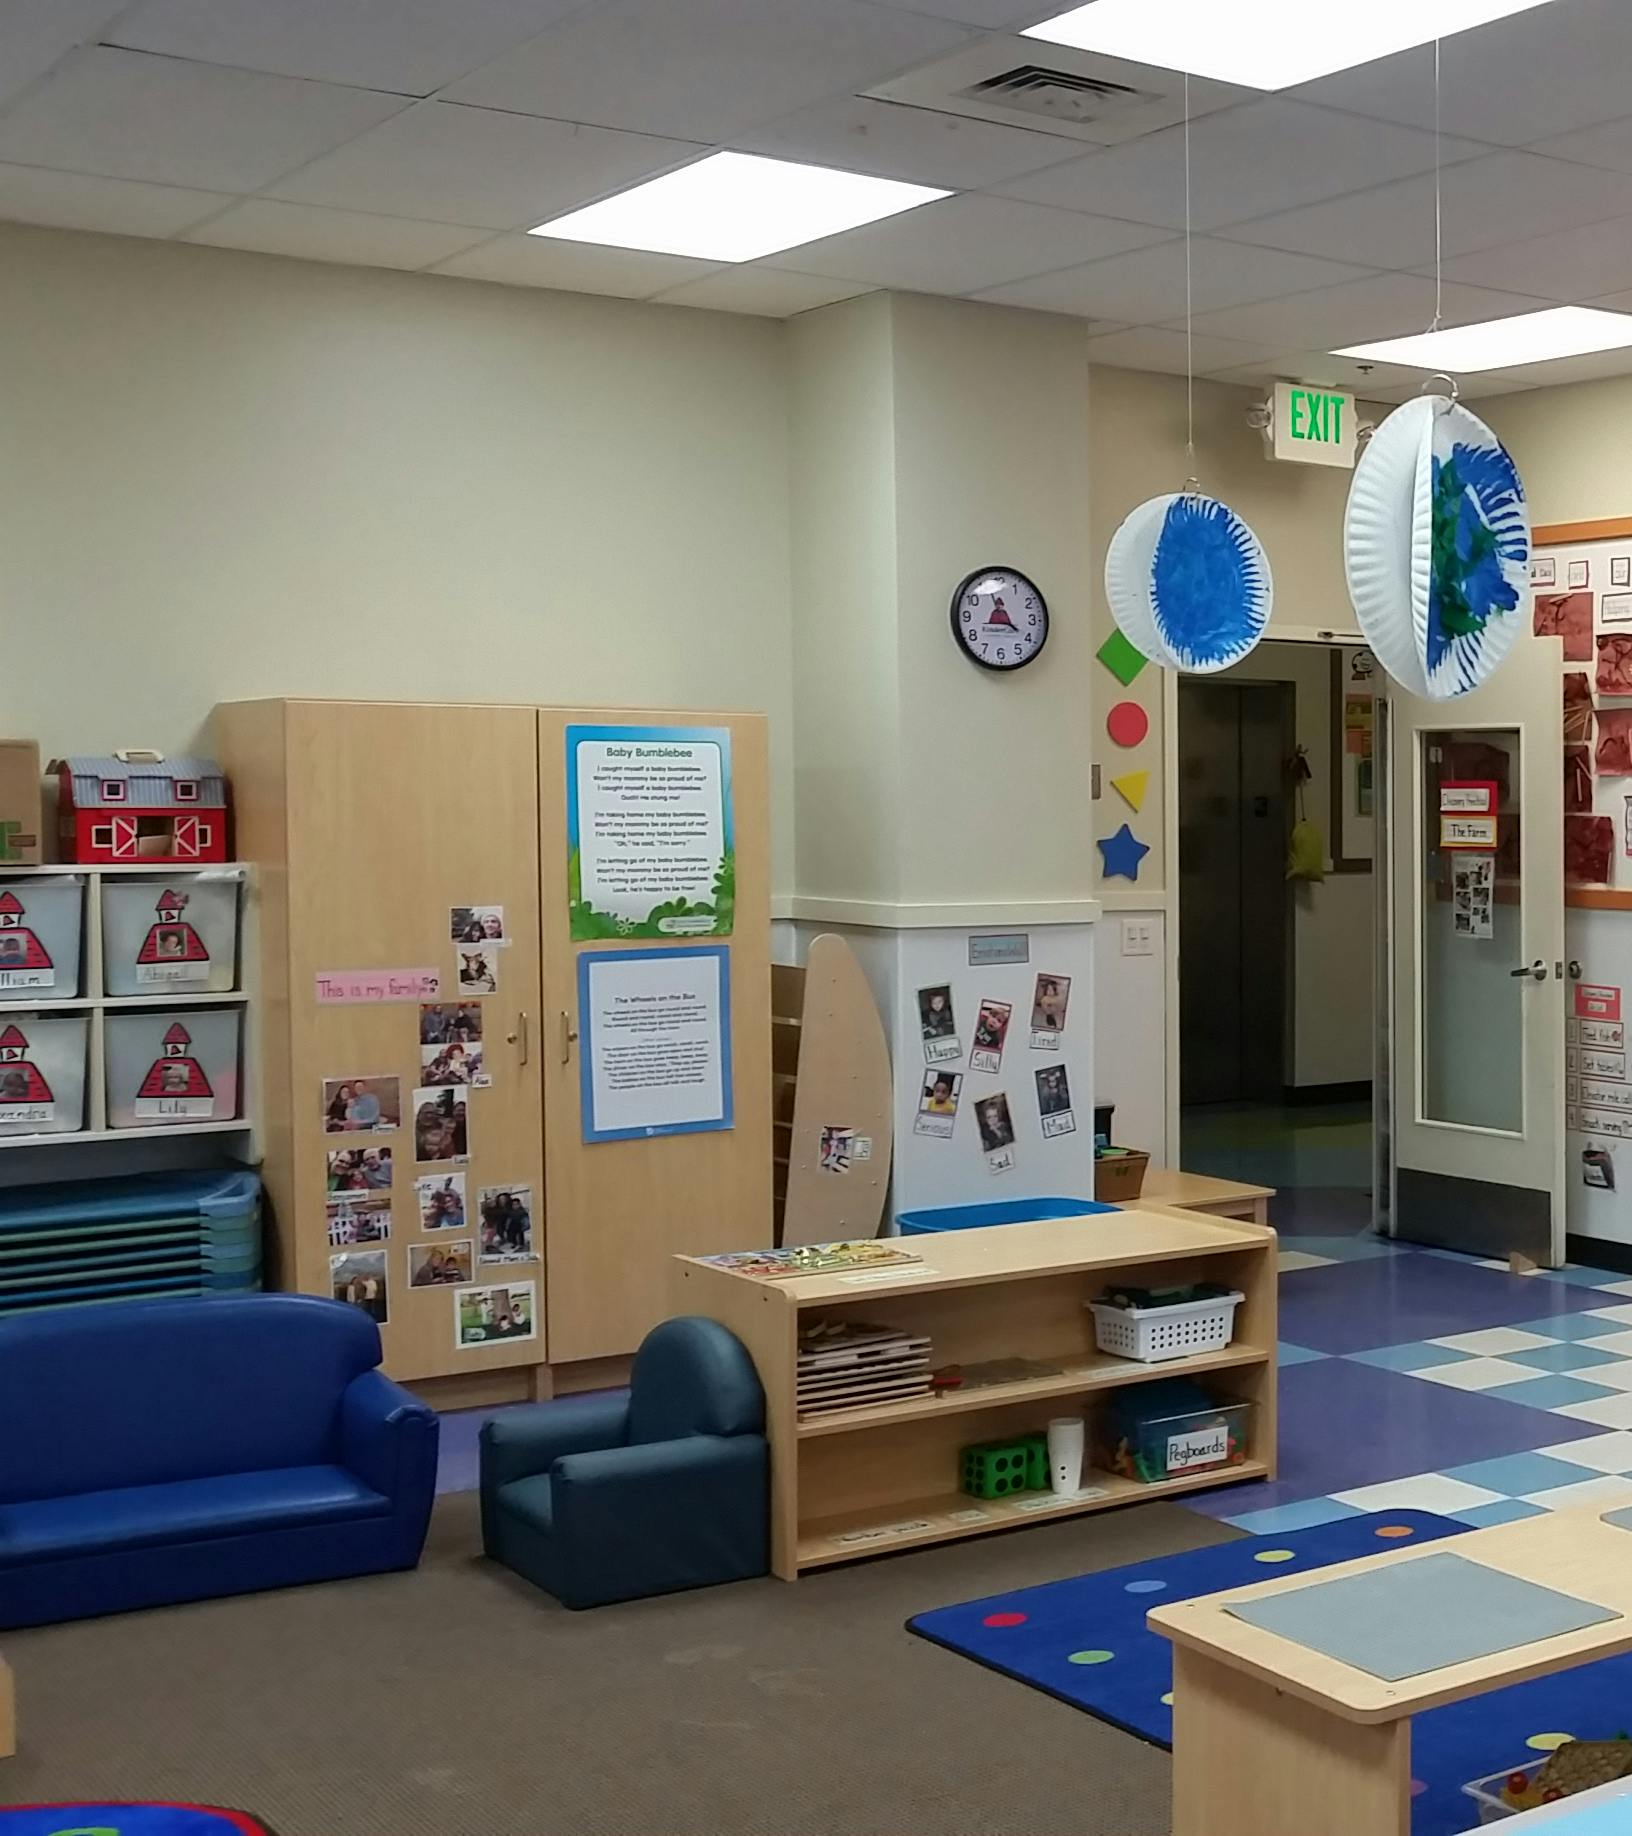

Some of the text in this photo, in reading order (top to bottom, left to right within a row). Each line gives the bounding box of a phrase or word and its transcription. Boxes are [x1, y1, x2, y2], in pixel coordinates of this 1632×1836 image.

[1291, 389, 1345, 444] EXIT
[1012, 584, 1018, 595] 1
[966, 594, 979, 607] 10
[1025, 597, 1033, 609] 2
[962, 610, 971, 623] 9
[1028, 614, 1036, 626] 3
[968, 629, 978, 641] 8
[1024, 632, 1032, 643] 4
[981, 643, 989, 655] 7
[996, 647, 1005, 660] 6
[1014, 643, 1023, 655] 5
[606, 747, 693, 759] Baby Bumblebee
[1451, 824, 1487, 838] The Farm
[317, 980, 344, 998] This
[350, 986, 361, 997] is
[367, 986, 383, 999] my
[927, 1043, 961, 1060] Happy
[974, 1051, 998, 1071] Silly
[1047, 1115, 1072, 1134] Mad
[990, 1152, 1011, 1171] Sad
[1169, 1434, 1225, 1467] Pegboards
